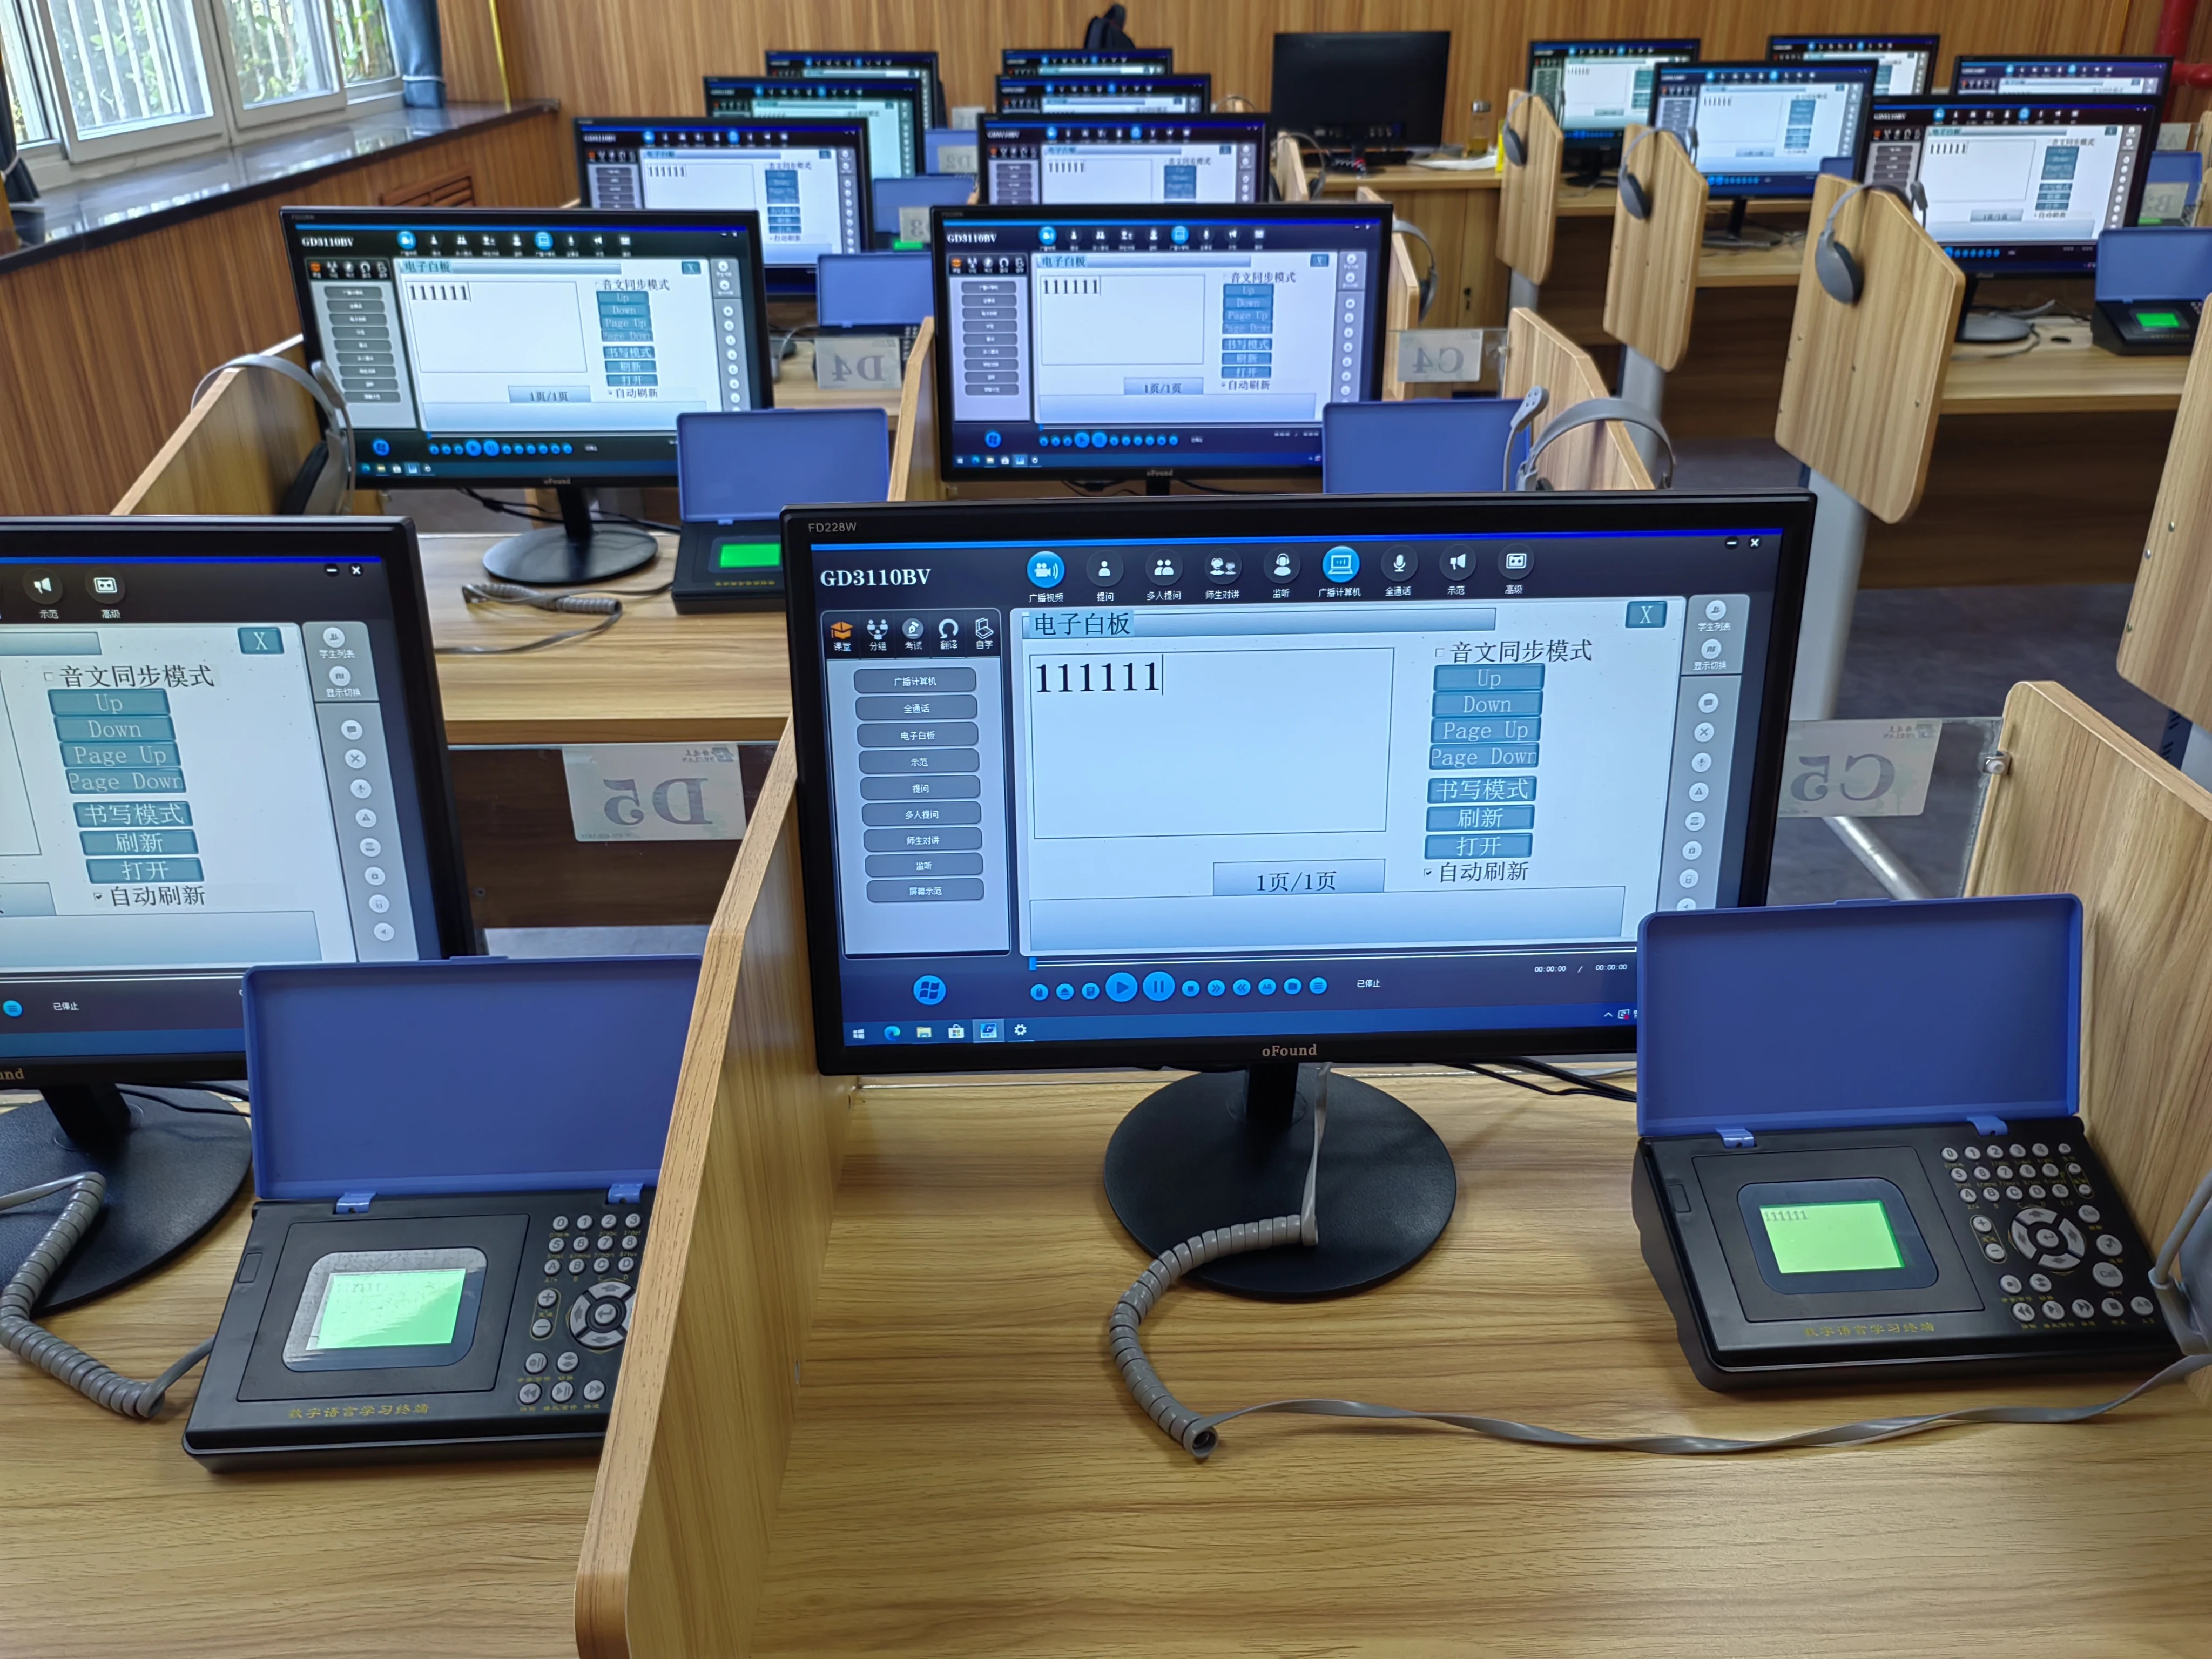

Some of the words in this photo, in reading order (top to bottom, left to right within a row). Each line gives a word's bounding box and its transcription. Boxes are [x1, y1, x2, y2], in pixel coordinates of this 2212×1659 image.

[301, 237, 354, 247] GD3110BV
[947, 233, 996, 243] GD3110BV
[1042, 256, 1086, 267] 电子白板
[404, 261, 451, 273] 电子白板
[687, 263, 694, 272] X
[603, 279, 670, 291] 音文同步模式
[1043, 279, 1098, 294] 111111
[409, 285, 468, 301] 111111
[1243, 286, 1255, 295] Up
[617, 293, 629, 303] Up
[1237, 298, 1260, 307] Down
[613, 306, 636, 315] Down
[1228, 312, 1251, 321] Page
[1256, 311, 1268, 321] Up
[605, 319, 629, 328] Page
[635, 319, 646, 328] Up
[621, 362, 641, 371] 刷新
[622, 376, 643, 385] 打开
[616, 388, 658, 398] 自动刷新
[1144, 383, 1181, 394] 1页/1页
[808, 522, 857, 533] FD228W
[820, 568, 931, 587] GD3110BV
[1205, 589, 1239, 600] 师生对讲
[1272, 588, 1290, 598] 监听
[1318, 587, 1361, 598] 广播计算机
[1385, 585, 1412, 596] 全通话
[1447, 585, 1465, 596] 示范
[1505, 584, 1523, 595] 高级
[1029, 592, 1064, 603] 广播视频
[1096, 591, 1114, 602] 提问
[1147, 590, 1182, 601] 多人提问
[39, 609, 59, 619] 示范
[102, 609, 121, 619] 高级
[1639, 605, 1653, 624] X
[1034, 612, 1130, 637] 电子白板
[1697, 622, 1731, 632] 学生列表
[253, 631, 268, 651] X
[905, 641, 922, 651] 考试
[940, 640, 958, 650] 翻译
[976, 640, 993, 650] 自学
[833, 642, 851, 652] 课堂
[869, 642, 887, 651] 分组
[1449, 639, 1593, 664] 音文同步模式
[319, 649, 355, 659] 学生列表
[1692, 660, 1727, 671] 显示切换
[59, 665, 214, 689] 音文同步模式
[894, 677, 937, 687] 广播计算机
[1035, 662, 1159, 693] 111111
[1477, 669, 1501, 689] Up
[326, 687, 361, 698] 显示切换
[96, 694, 124, 713] Up
[903, 704, 930, 713] 全通话
[1463, 696, 1512, 713] Down
[90, 720, 142, 738] Down
[1443, 722, 1492, 741] Page
[1505, 720, 1528, 740] Up
[900, 731, 935, 740] 电子白板
[73, 746, 127, 766] Page
[141, 746, 166, 765] Up
[1432, 748, 1478, 768] Page
[1491, 746, 1536, 765] Down
[911, 758, 928, 767] 示范
[70, 774, 119, 792] Page
[132, 773, 183, 790] Down
[912, 784, 929, 794] 提问
[1437, 778, 1528, 801] 书写模式
[84, 802, 185, 826] 书写模式
[905, 810, 939, 820] 多人提问
[1457, 807, 1503, 828] 刷新
[116, 832, 163, 853] 刷新
[906, 836, 940, 846] 师生对讲
[1456, 835, 1501, 857] 打开
[122, 860, 169, 881] 打开
[916, 861, 932, 871] 监听
[1439, 861, 1529, 882] 自动刷新
[1256, 871, 1337, 893] 1页/1页
[111, 886, 206, 906] 自动刷新
[909, 887, 942, 896] 屏幕示范
[1534, 965, 1567, 973] 00:00:00
[1595, 963, 1627, 972] 00:00:00
[1357, 979, 1380, 989] 已停止
[53, 1002, 79, 1011] 已停止
[1262, 1044, 1317, 1057] oFound
[1992, 1147, 1999, 1155] 2
[1965, 1190, 1972, 1198] A
[606, 1216, 612, 1224] 2
[630, 1216, 637, 1224] 3
[1764, 1210, 1808, 1222] 111111
[557, 1218, 564, 1226] 0
[553, 1240, 561, 1249] 5
[577, 1239, 584, 1247] 6
[603, 1238, 609, 1246] 7
[626, 1237, 633, 1245] 8
[548, 1262, 556, 1270] A
[574, 1262, 581, 1270] B
[623, 1259, 631, 1267] D
[1804, 1323, 1934, 1337] 数字语言学习终端
[288, 1404, 430, 1418] 数字语言学习终端
